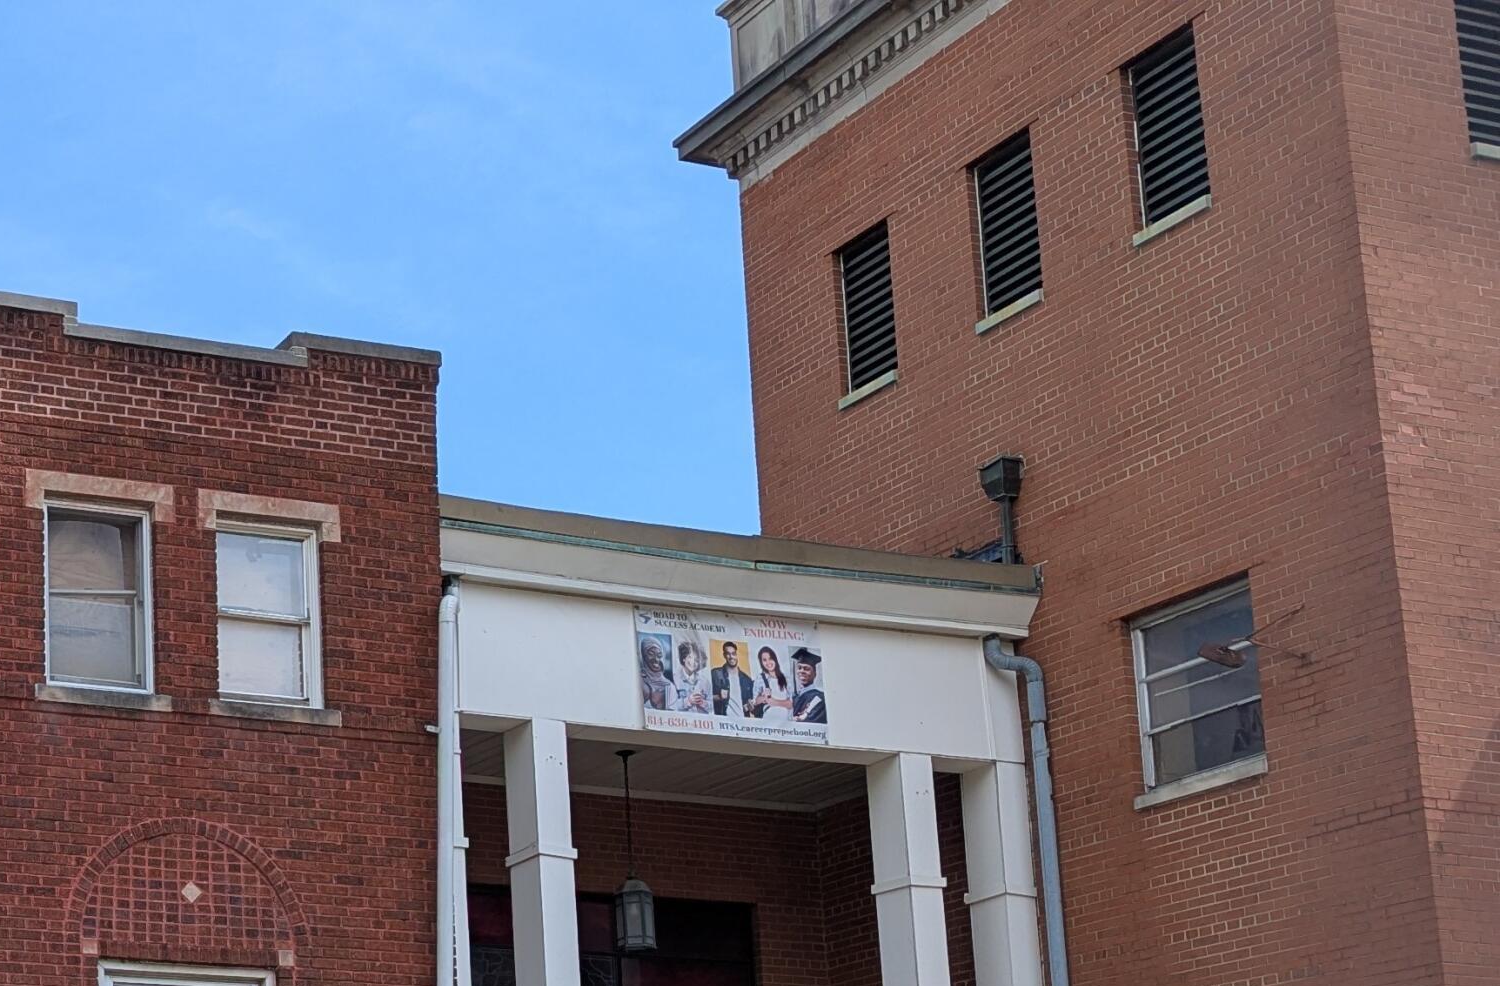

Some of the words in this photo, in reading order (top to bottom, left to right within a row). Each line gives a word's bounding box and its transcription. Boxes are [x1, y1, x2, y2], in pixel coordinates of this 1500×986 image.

[653, 611, 675, 620] ROAD
[676, 613, 687, 621] TO
[654, 620, 688, 630] SUCCESS
[689, 623, 726, 633] ACADEMY
[760, 619, 787, 630] NOW
[743, 628, 805, 641] ENROLLING!
